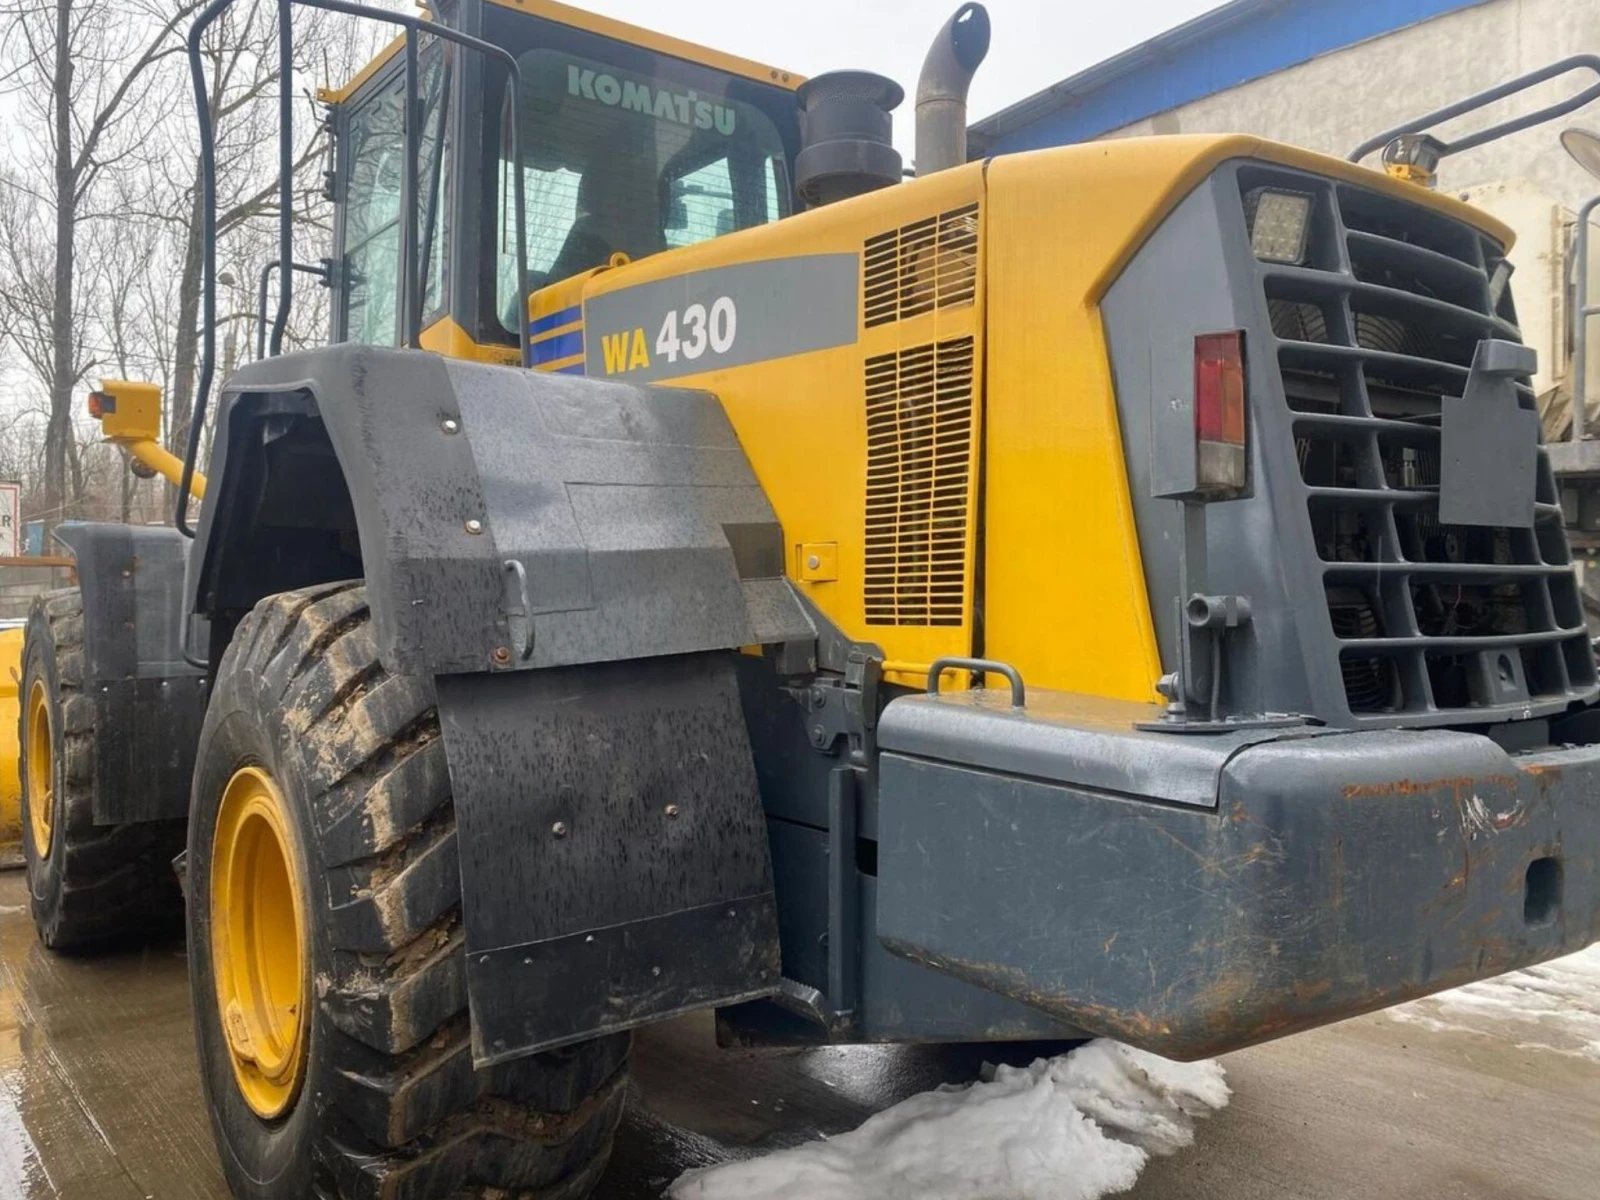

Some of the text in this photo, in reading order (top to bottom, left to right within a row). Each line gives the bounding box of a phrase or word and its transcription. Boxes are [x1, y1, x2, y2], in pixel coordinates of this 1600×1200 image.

[567, 64, 736, 136] KOMATSU
[601, 296, 737, 376] WA 430
